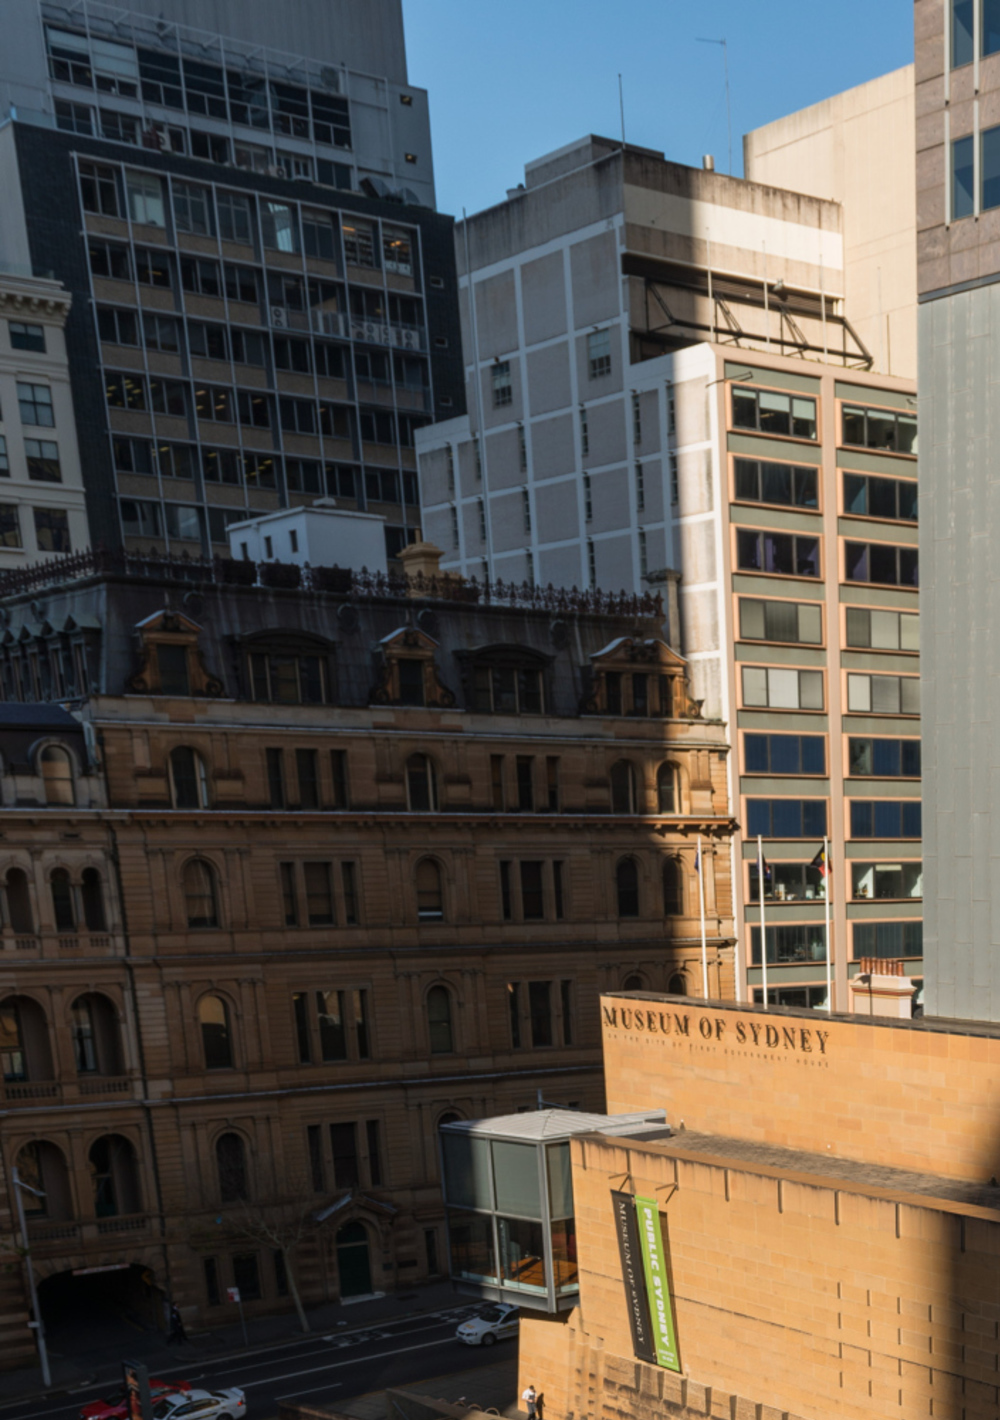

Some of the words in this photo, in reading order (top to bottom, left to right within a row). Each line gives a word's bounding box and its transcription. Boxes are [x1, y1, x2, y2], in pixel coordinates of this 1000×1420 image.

[603, 1006, 690, 1037] MUSEUM
[699, 1016, 726, 1041] OF
[736, 1021, 830, 1055] SYDNEY
[619, 1201, 632, 1265] MUSEUM
[643, 1207, 660, 1271] PUBLIC
[652, 1275, 670, 1348] SYDNEY
